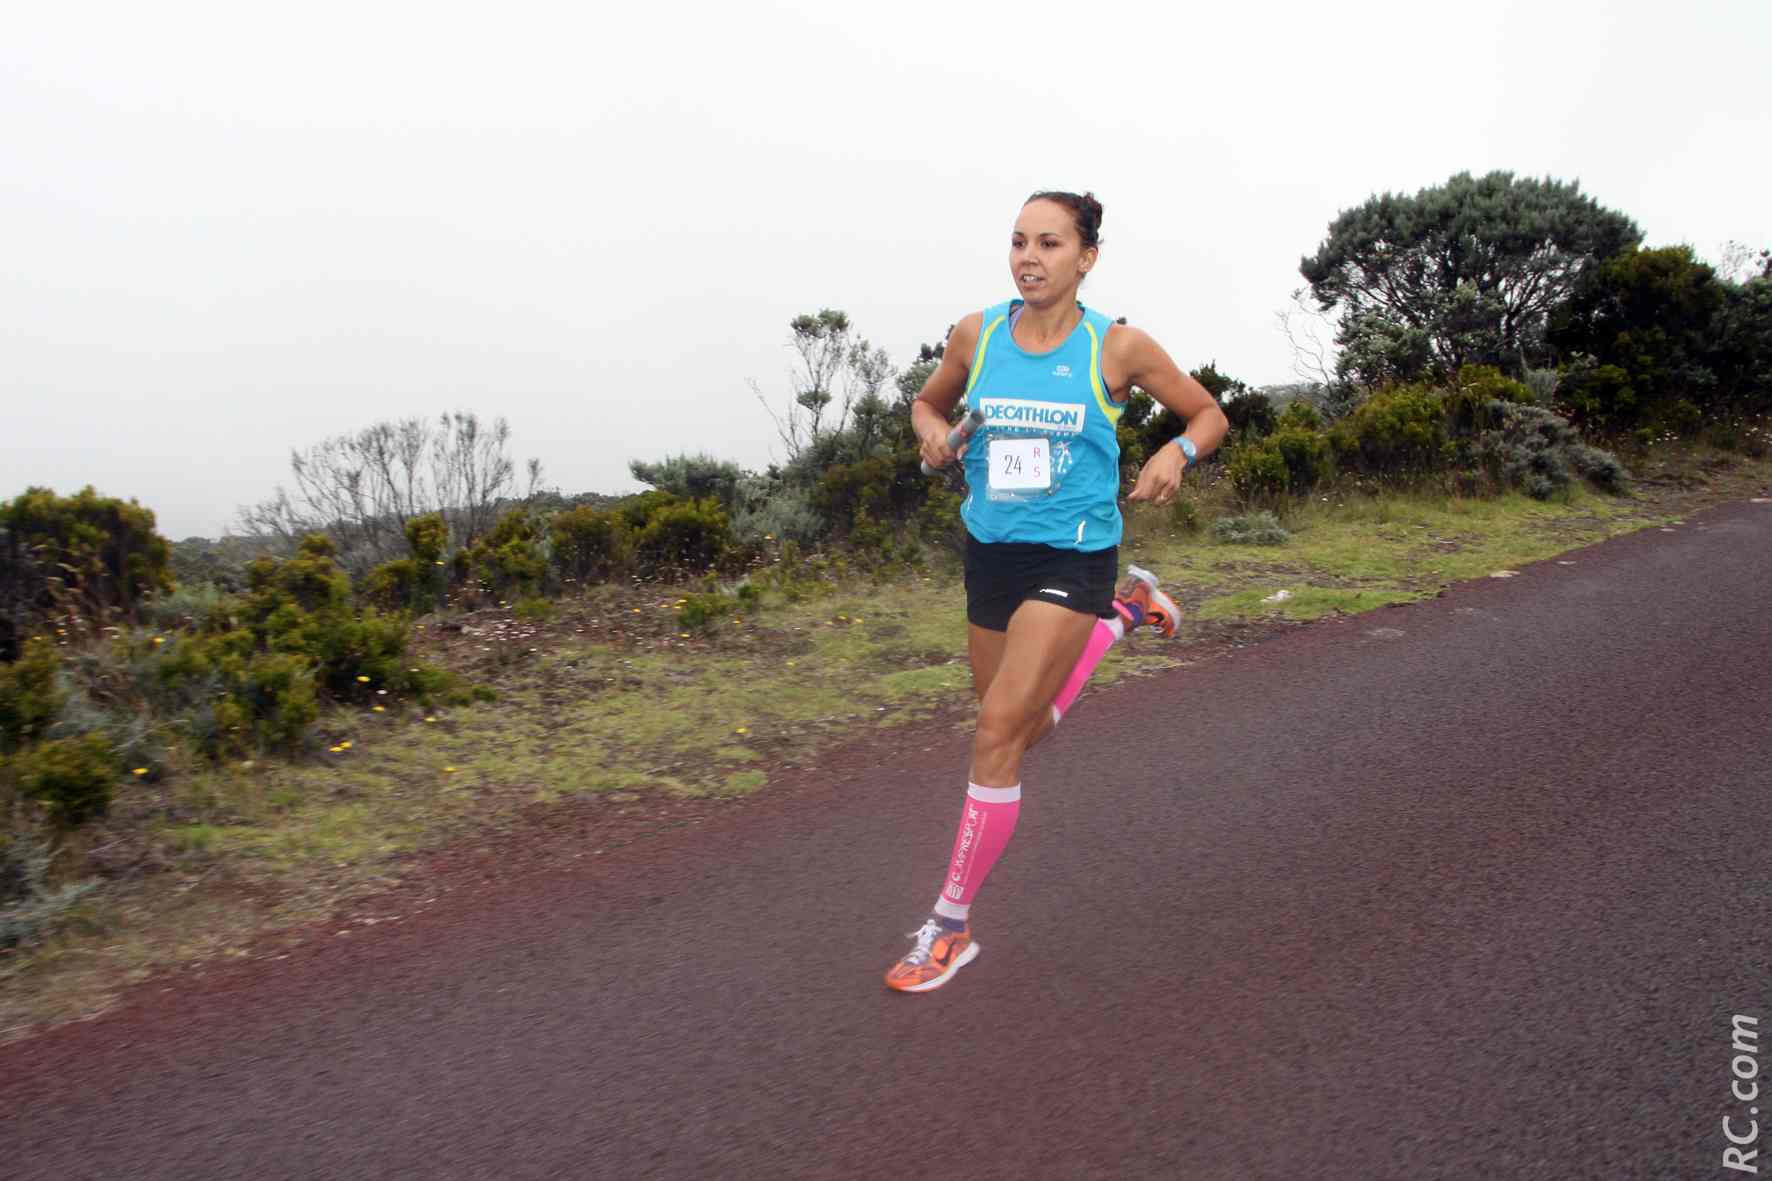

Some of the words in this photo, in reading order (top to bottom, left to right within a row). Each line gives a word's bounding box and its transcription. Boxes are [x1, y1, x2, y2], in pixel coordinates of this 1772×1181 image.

[984, 403, 1078, 425] DECATHLON
[1033, 446, 1041, 459] R
[1003, 454, 1022, 476] 24
